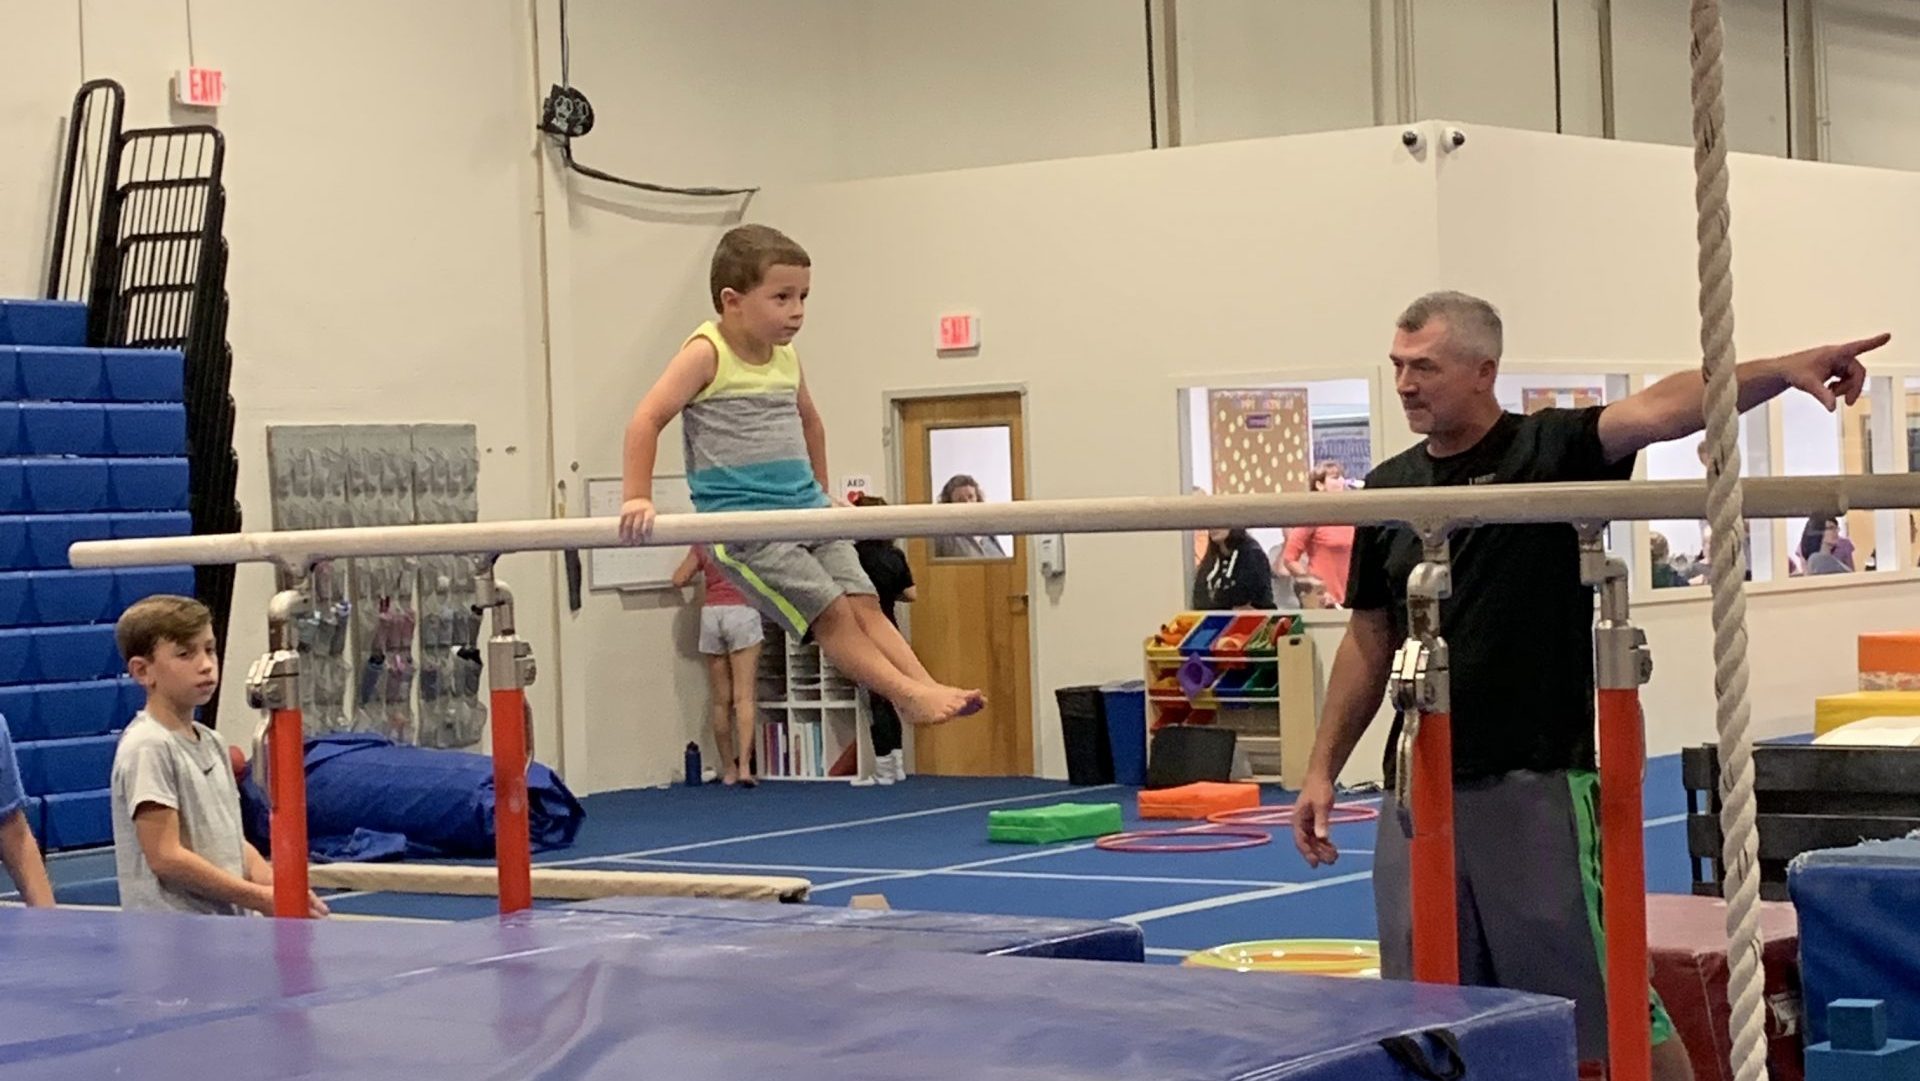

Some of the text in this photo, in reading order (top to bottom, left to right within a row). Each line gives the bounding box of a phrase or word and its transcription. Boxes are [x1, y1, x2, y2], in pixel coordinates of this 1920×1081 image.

[190, 69, 222, 102] EXIT
[941, 316, 970, 345] EXIT
[847, 479, 865, 487] AED
